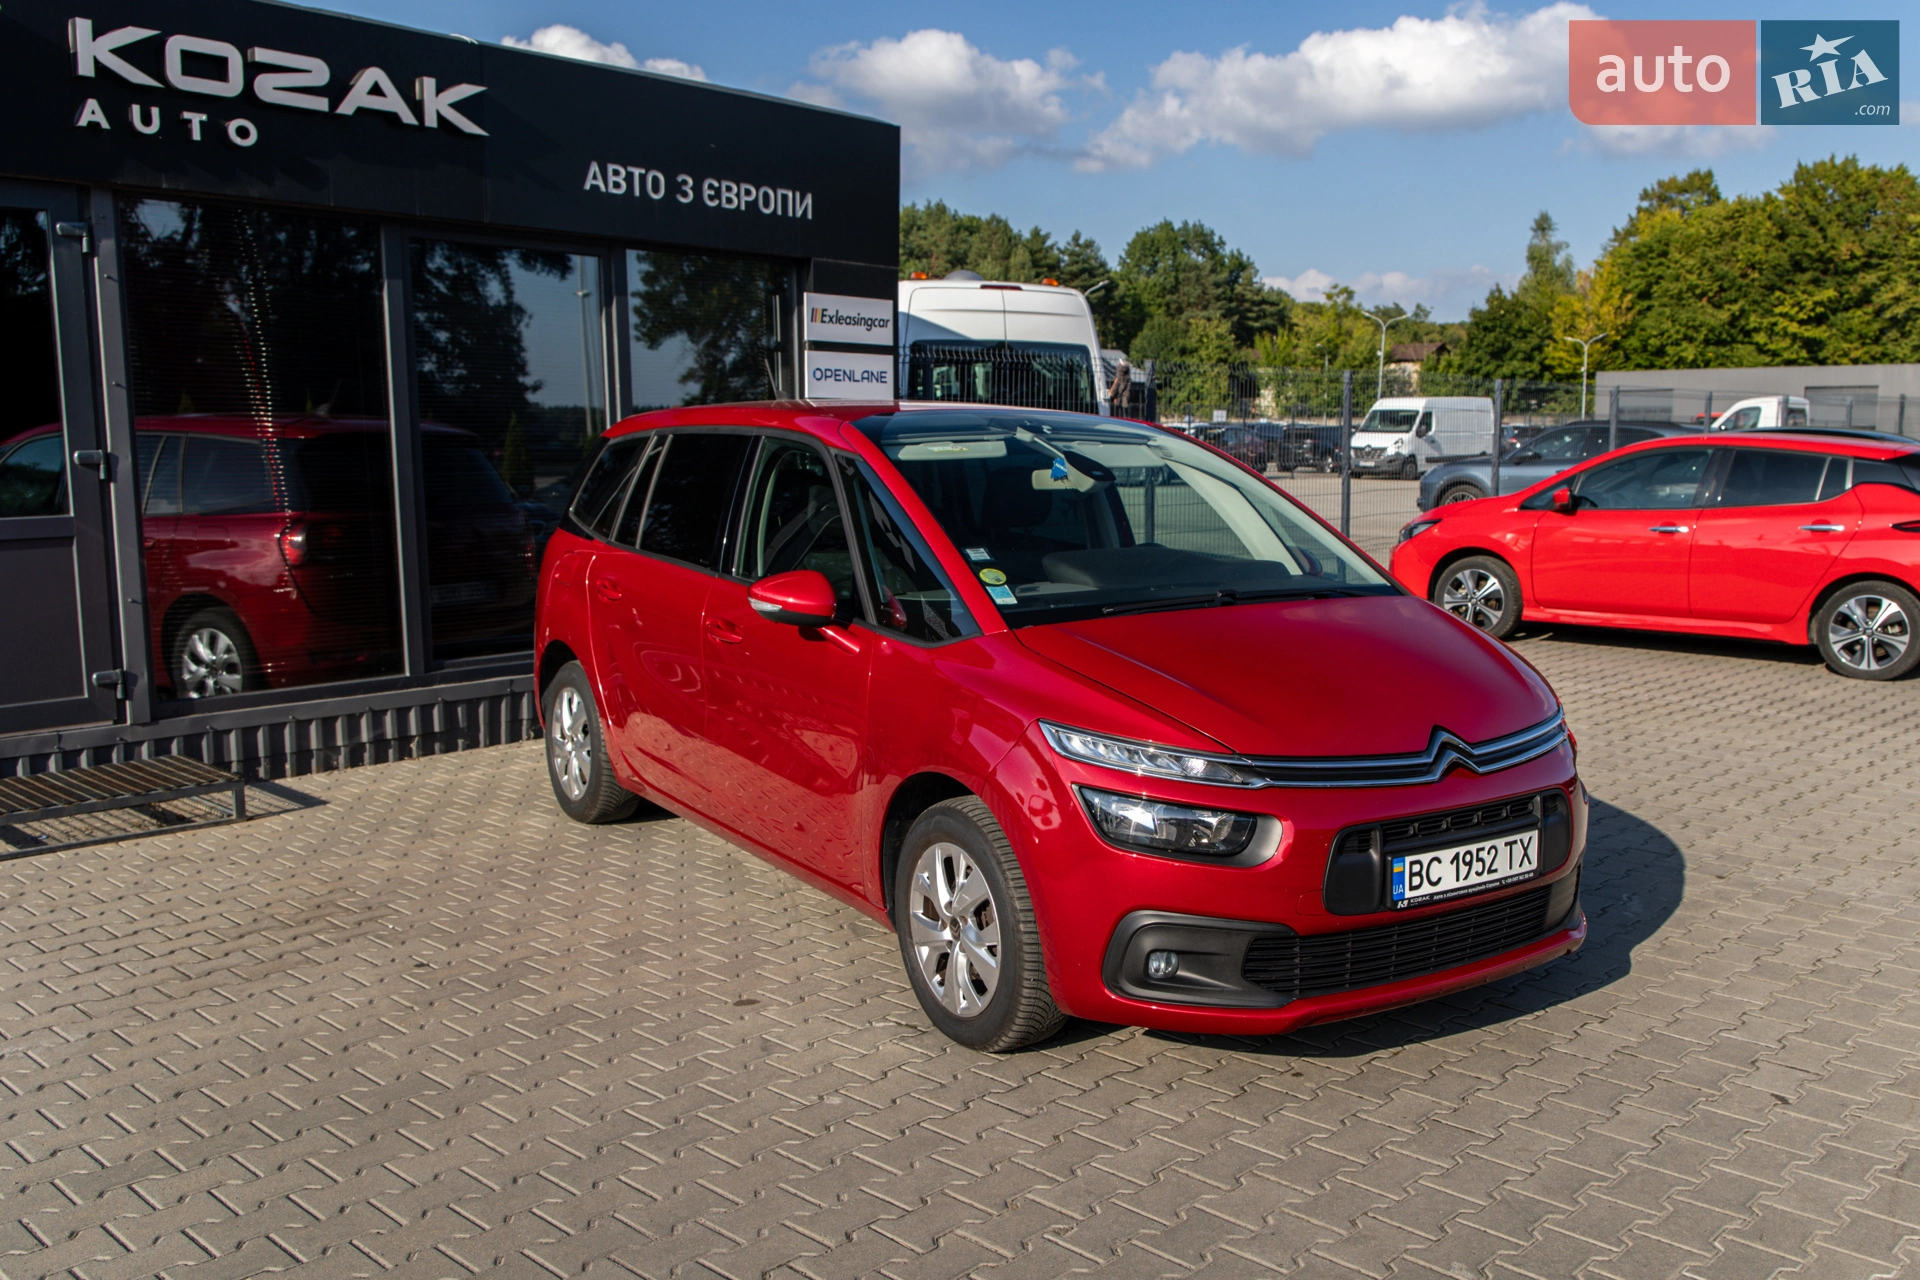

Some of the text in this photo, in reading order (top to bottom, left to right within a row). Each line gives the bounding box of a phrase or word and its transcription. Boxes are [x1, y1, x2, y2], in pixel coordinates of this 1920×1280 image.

[68, 17, 490, 137] KOZAK
[75, 98, 259, 147] AUTO
[583, 160, 666, 200] АВТО
[702, 177, 813, 220] ЄВРОПИ
[820, 307, 890, 332] Exleasingcar
[812, 367, 888, 384] OPENLANE
[1408, 835, 1533, 892] BC 1952 TX
[1392, 884, 1404, 896] UA
